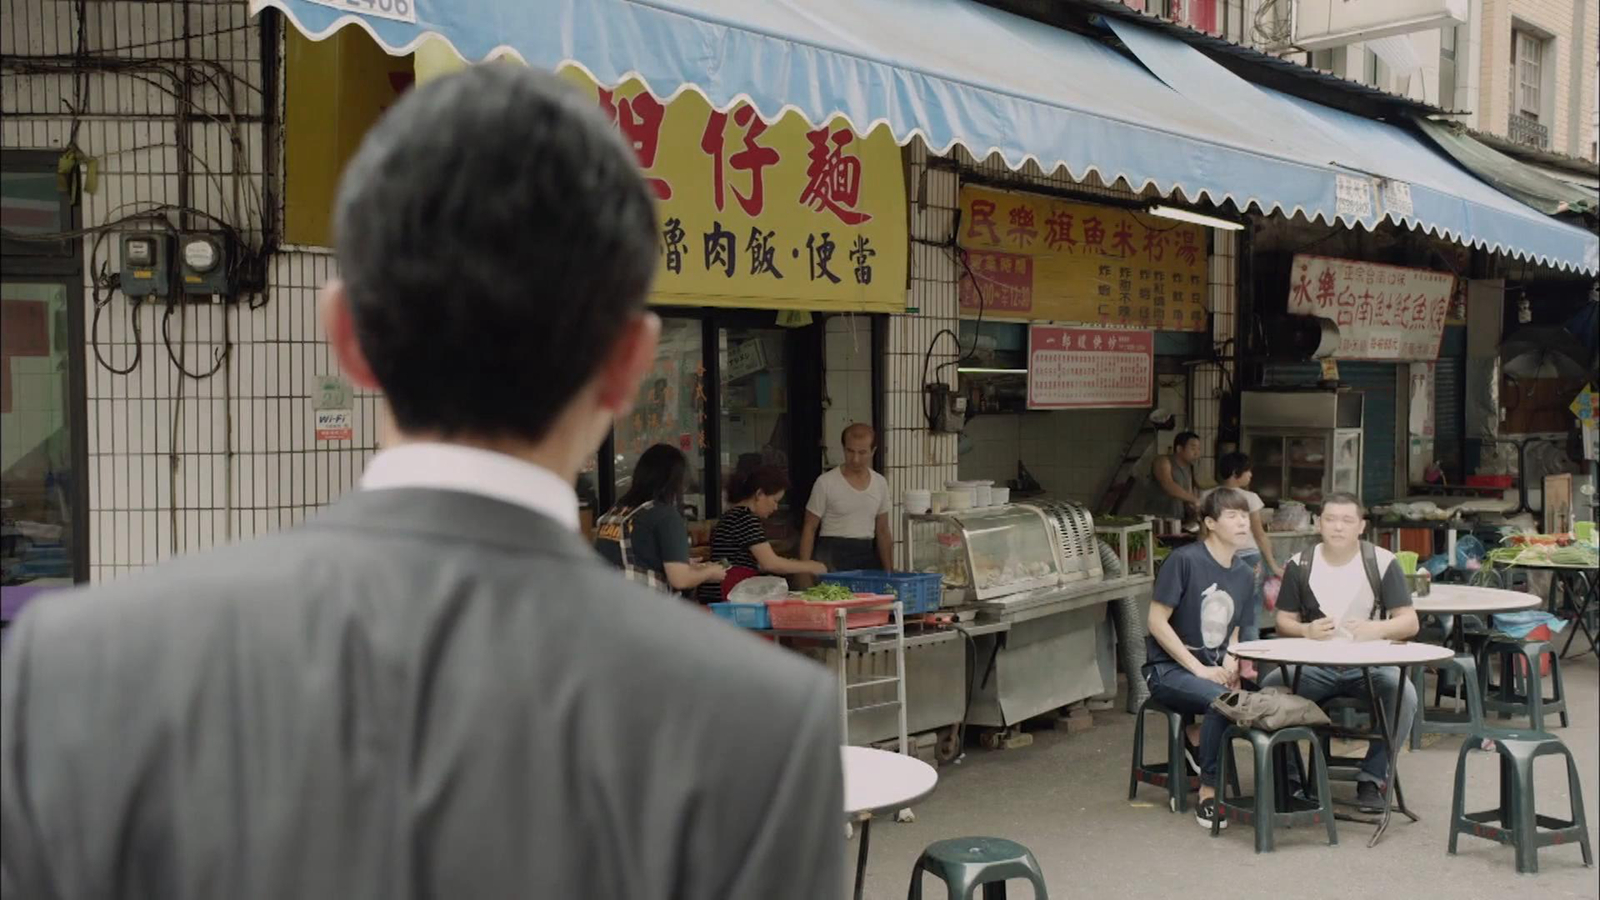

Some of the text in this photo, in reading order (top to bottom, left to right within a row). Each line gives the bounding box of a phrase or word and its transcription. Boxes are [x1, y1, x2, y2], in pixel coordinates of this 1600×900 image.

[967, 199, 1200, 268] 民樂旗魚米粉湯
[1293, 264, 1336, 309] 永樂
[319, 413, 346, 424] Wi-Fi
